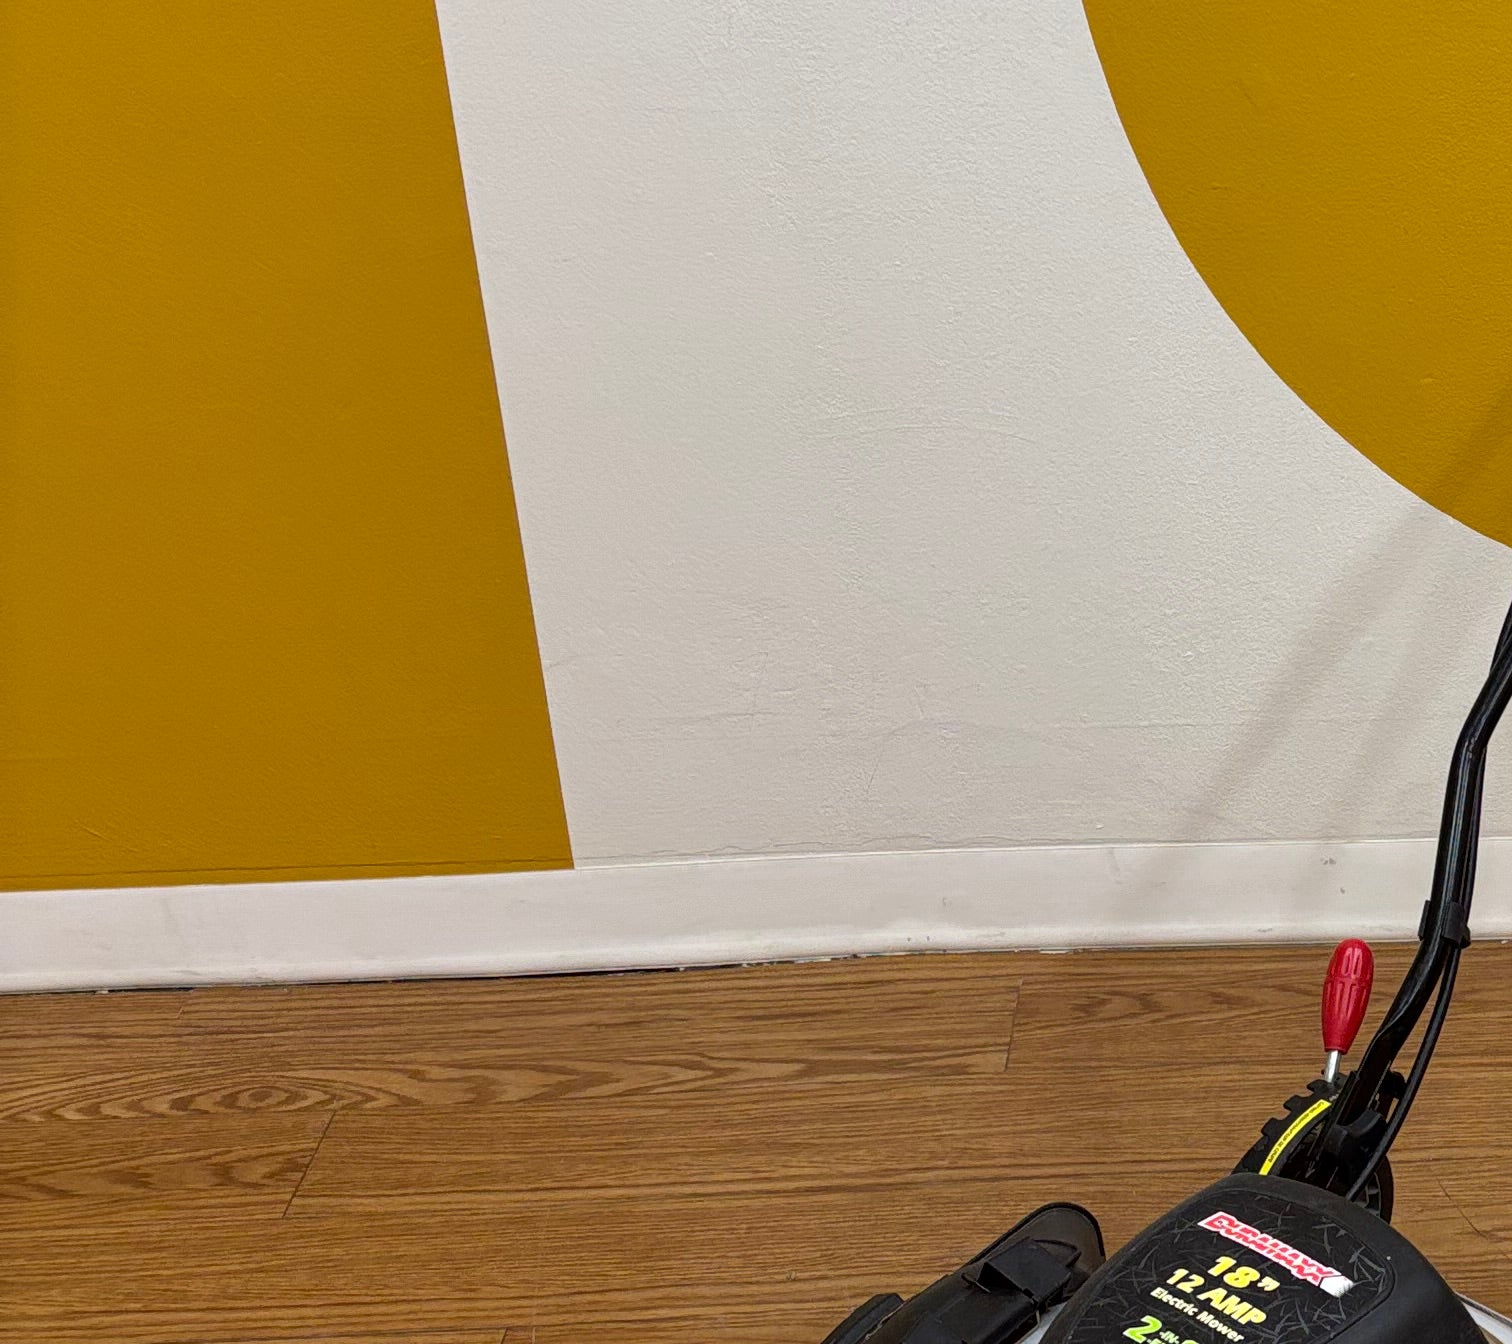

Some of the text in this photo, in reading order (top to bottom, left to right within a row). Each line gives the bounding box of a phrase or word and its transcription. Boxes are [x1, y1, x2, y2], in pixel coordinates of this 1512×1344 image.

[1150, 1286, 1245, 1342] Electric Mower
[1166, 1268, 1267, 1325] 12 AMP
[1123, 1315, 1162, 1344] 2
